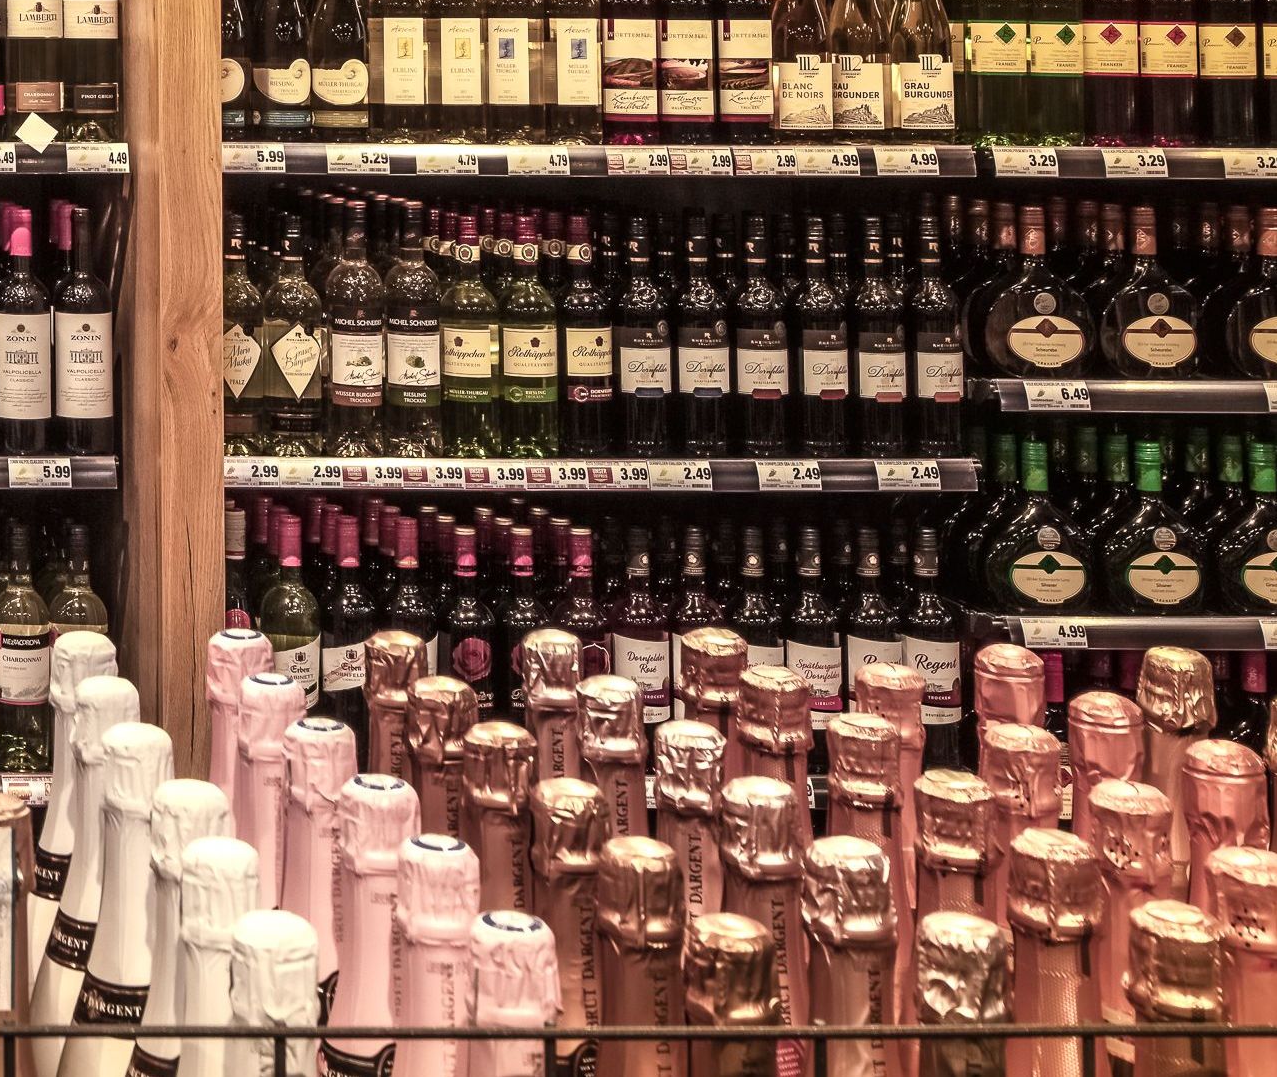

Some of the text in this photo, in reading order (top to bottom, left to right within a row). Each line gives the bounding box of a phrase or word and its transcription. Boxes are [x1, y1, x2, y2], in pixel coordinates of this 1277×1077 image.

[904, 91, 953, 99] BURGUNDER
[109, 153, 127, 164] 4.49
[257, 151, 284, 162] 5.99
[361, 153, 388, 164] 5.29
[649, 155, 668, 166] 2.99
[712, 155, 731, 166] 2.99
[832, 155, 859, 166] 4.99
[910, 154, 938, 165] 4.99
[1029, 155, 1056, 166] 3.29
[1138, 155, 1165, 166] 3.29
[1061, 389, 1089, 400] 6.49
[43, 466, 70, 477] 5.99
[251, 466, 279, 477] 2.99
[314, 466, 341, 477] 2.99
[375, 468, 402, 479] 3.99
[435, 468, 462, 479] 3.99
[497, 469, 525, 480] 3.99
[559, 468, 586, 480] 3.99
[620, 469, 647, 480] 3.99
[684, 469, 711, 480] 2.49
[793, 469, 820, 480] 2.49
[911, 468, 939, 479] 2.49
[1058, 626, 1085, 638] 4.99
